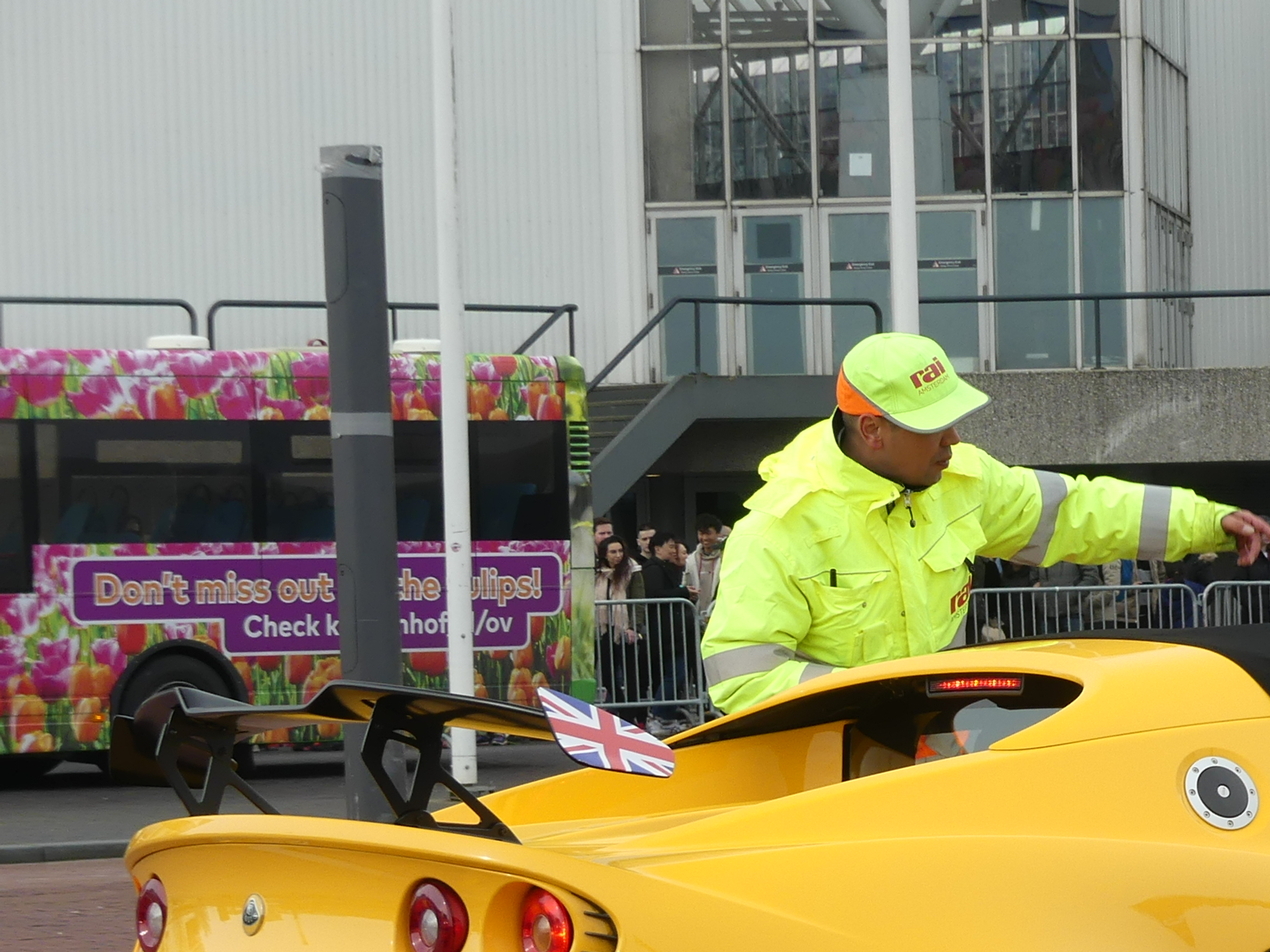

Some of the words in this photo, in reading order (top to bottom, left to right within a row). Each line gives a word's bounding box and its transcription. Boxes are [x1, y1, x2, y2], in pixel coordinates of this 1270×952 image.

[909, 356, 946, 389] rai
[918, 374, 951, 396] AMSTERDAM
[94, 571, 190, 606] Don't
[195, 570, 271, 604] miss
[278, 573, 335, 603] out
[243, 613, 320, 637] Check
